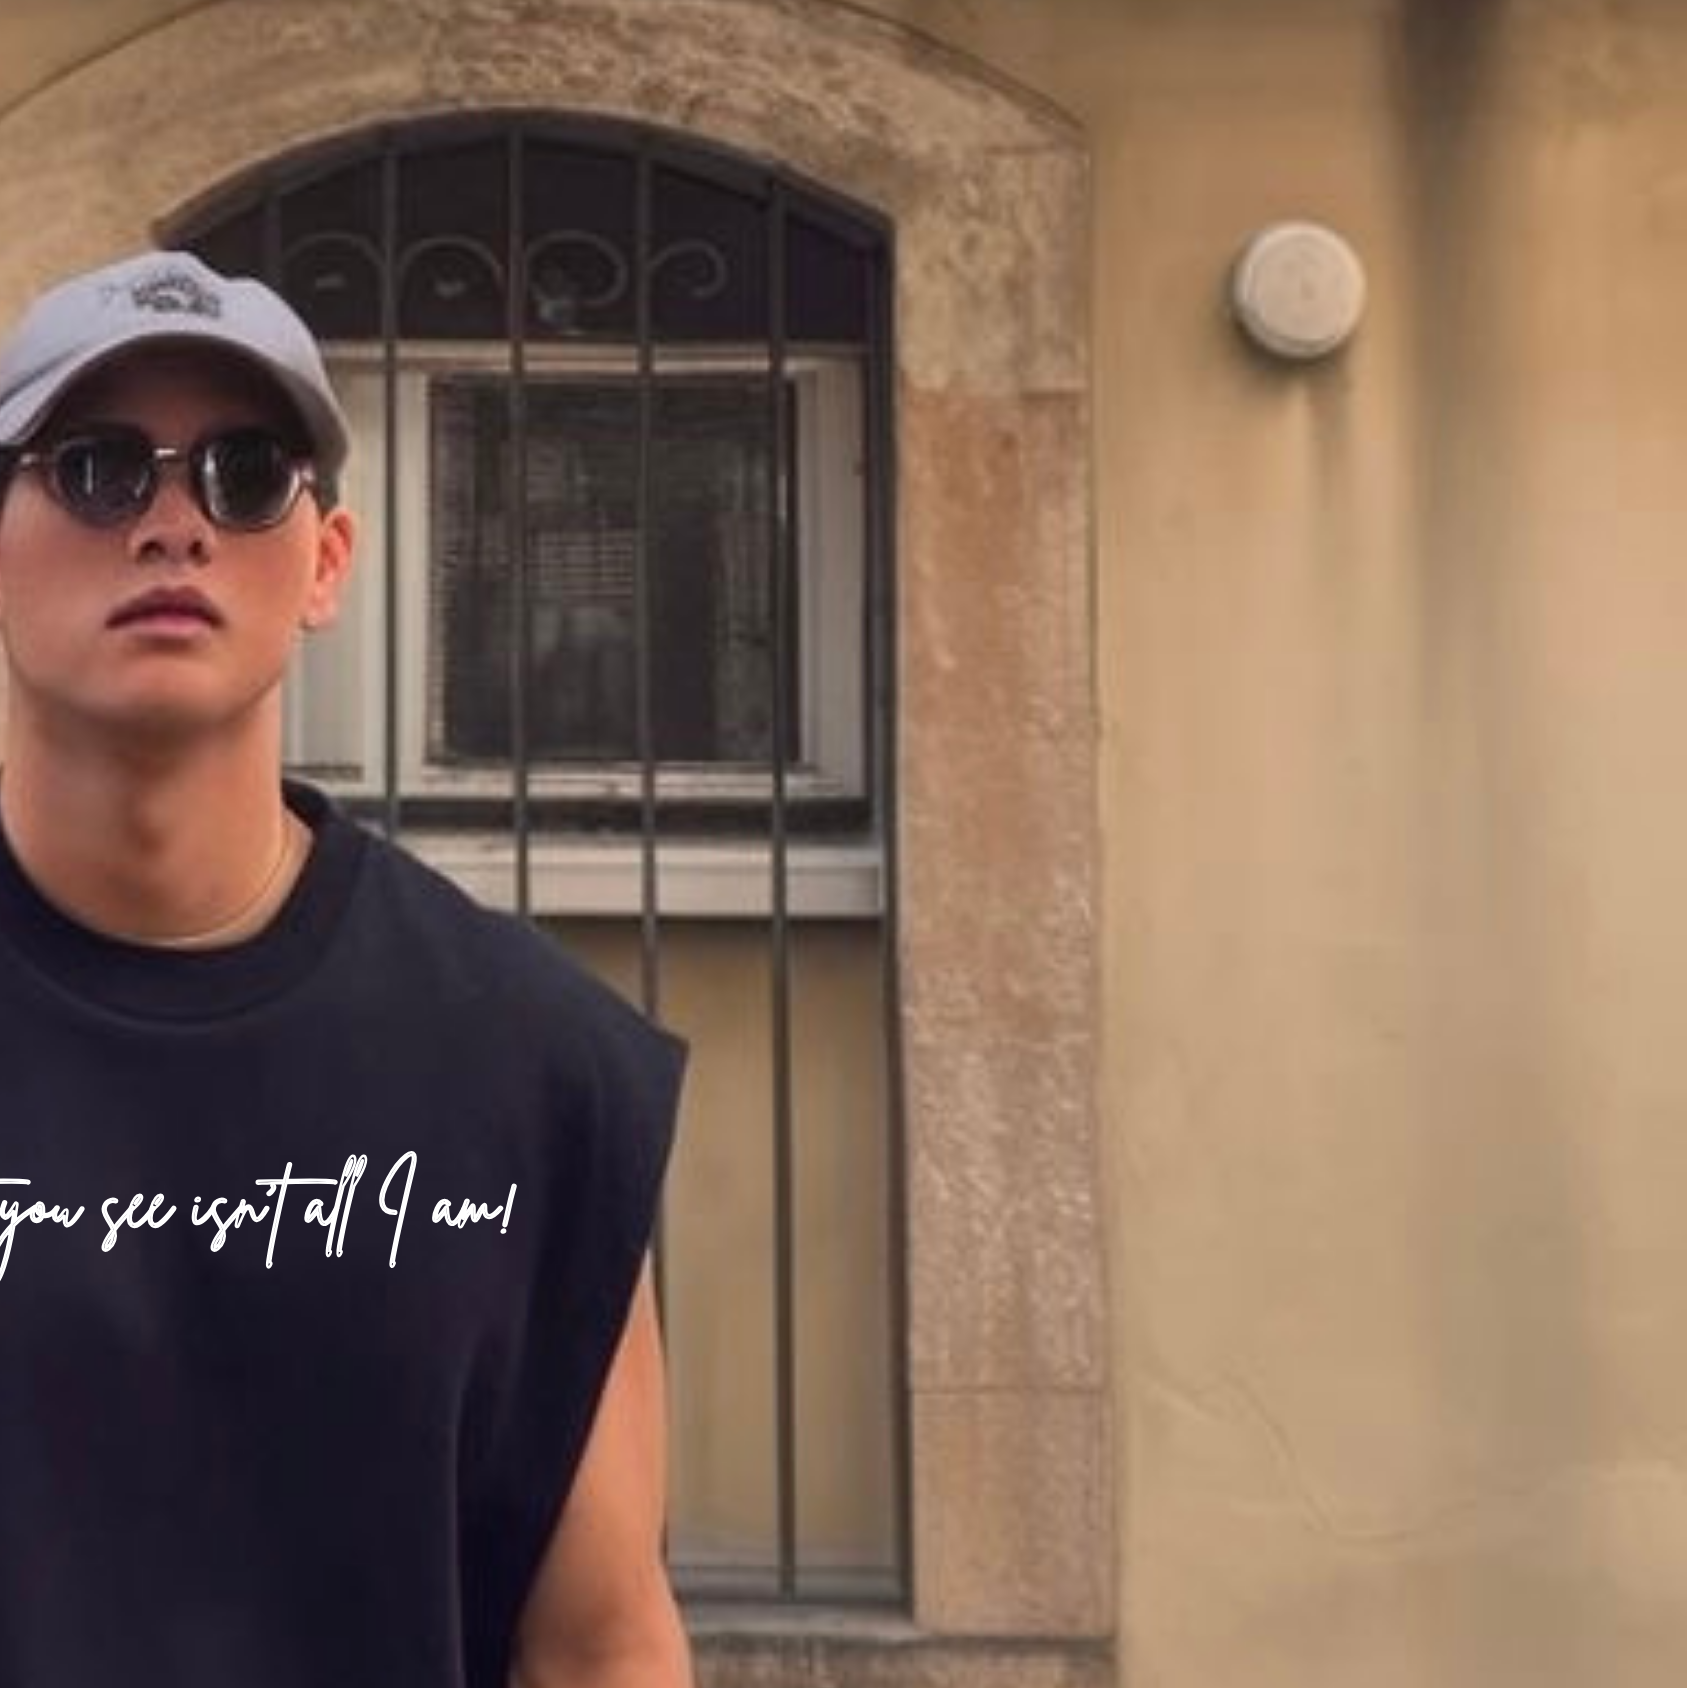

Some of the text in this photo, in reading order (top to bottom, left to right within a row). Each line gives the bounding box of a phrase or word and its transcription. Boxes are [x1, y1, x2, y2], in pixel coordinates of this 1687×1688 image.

[100, 1192, 178, 1253] see
[191, 1161, 339, 1270] isn't
[303, 1153, 368, 1258] all
[378, 1150, 418, 1269] I
[431, 1182, 518, 1235] am!
